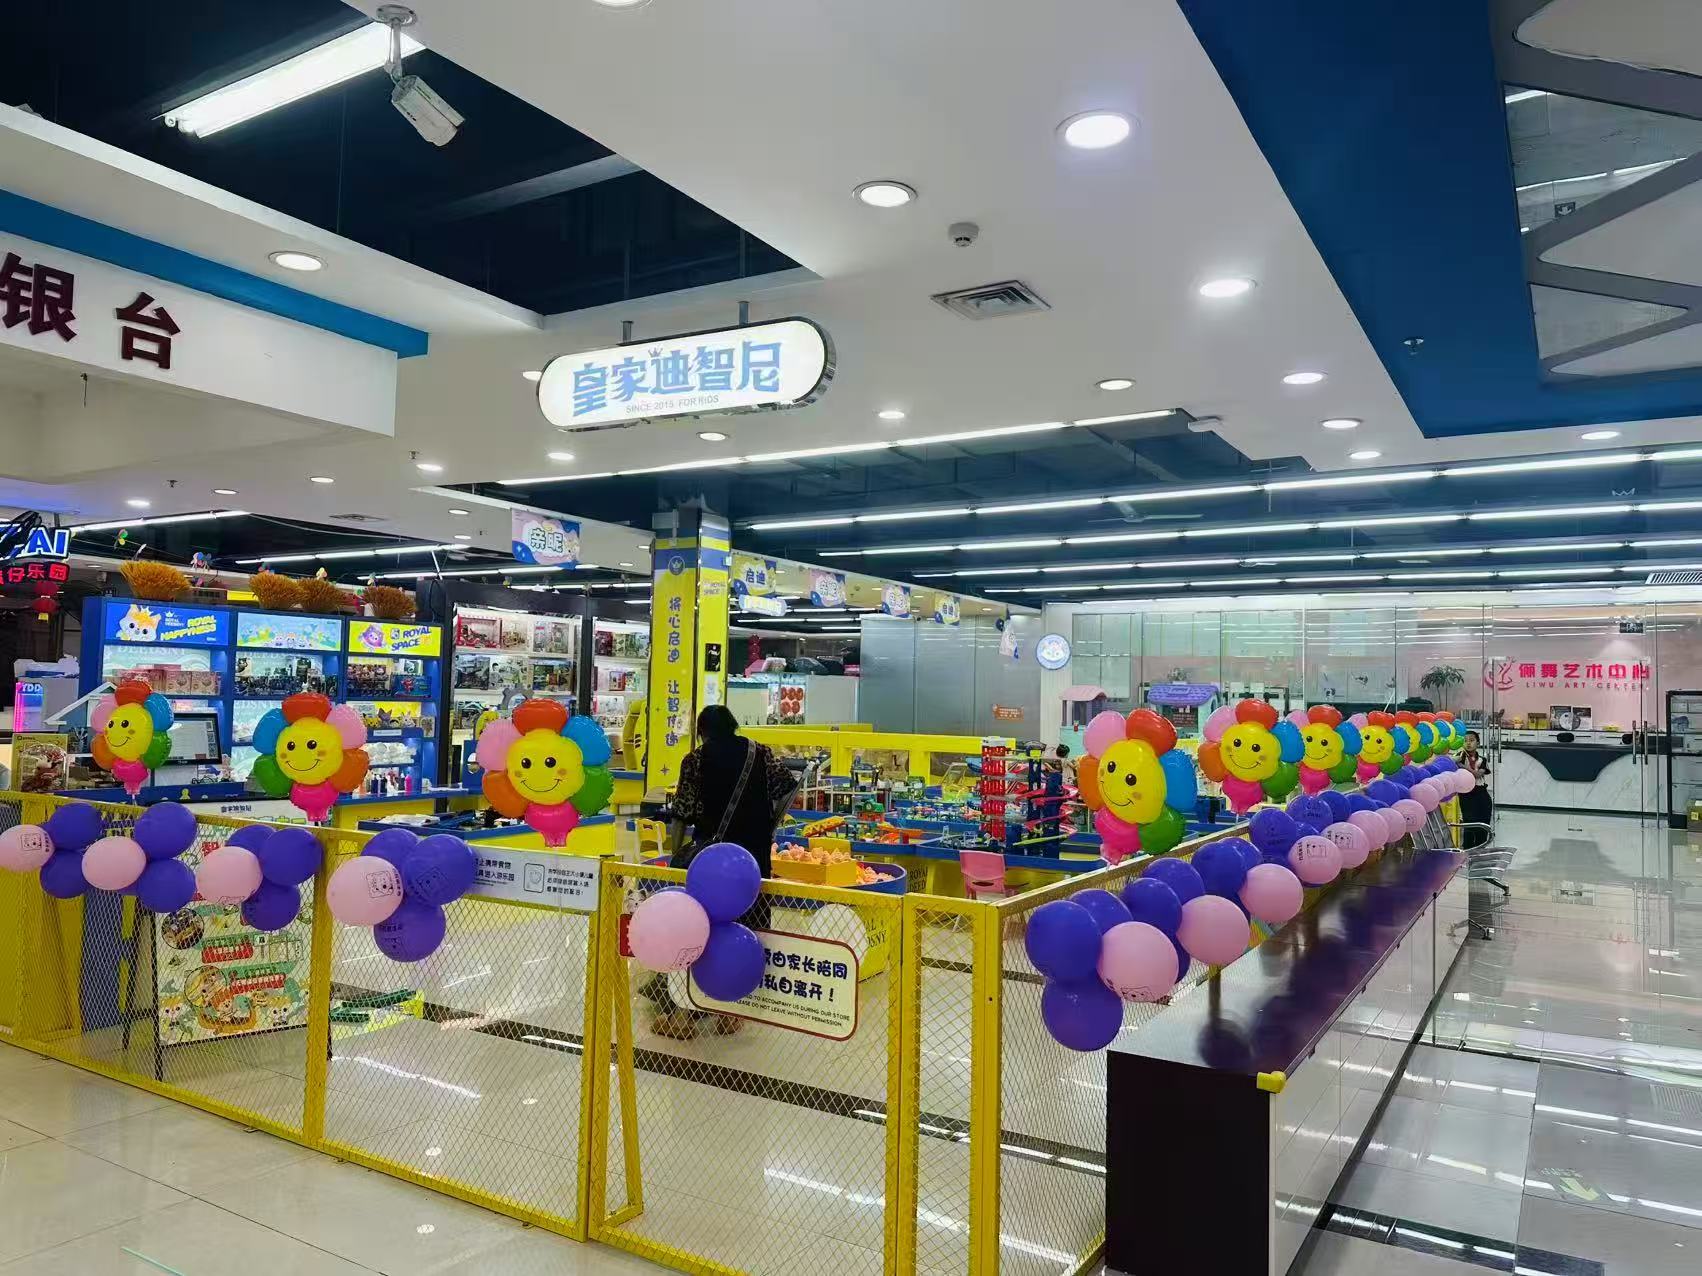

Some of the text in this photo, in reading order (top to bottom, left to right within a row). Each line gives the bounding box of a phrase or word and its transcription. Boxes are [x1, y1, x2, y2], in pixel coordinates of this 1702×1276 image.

[0, 252, 181, 370] 银台
[573, 342, 782, 417] 皇家迪智尼
[626, 402, 652, 414] SINCE
[654, 401, 674, 411] 2015
[678, 397, 696, 408] FOR
[530, 527, 564, 553] 亲昵
[0, 564, 69, 584] 仔乐园
[746, 567, 766, 585] 启迪
[403, 626, 432, 638] ROYAL
[391, 638, 420, 651] SPACE
[1518, 663, 1650, 680] 俪舞艺术中心
[1526, 681, 1554, 689] LIWU
[1564, 681, 1586, 689] ART
[475, 869, 515, 882] 具进入游乐园
[760, 1003, 771, 1012] NOT
[771, 1006, 786, 1016] LEAVE
[786, 1009, 811, 1020] WITHOUT
[762, 996, 792, 1008] ACCOMPANY
[800, 1005, 820, 1015] DURING
[821, 1009, 832, 1018] OUR
[832, 1011, 851, 1022] STORE
